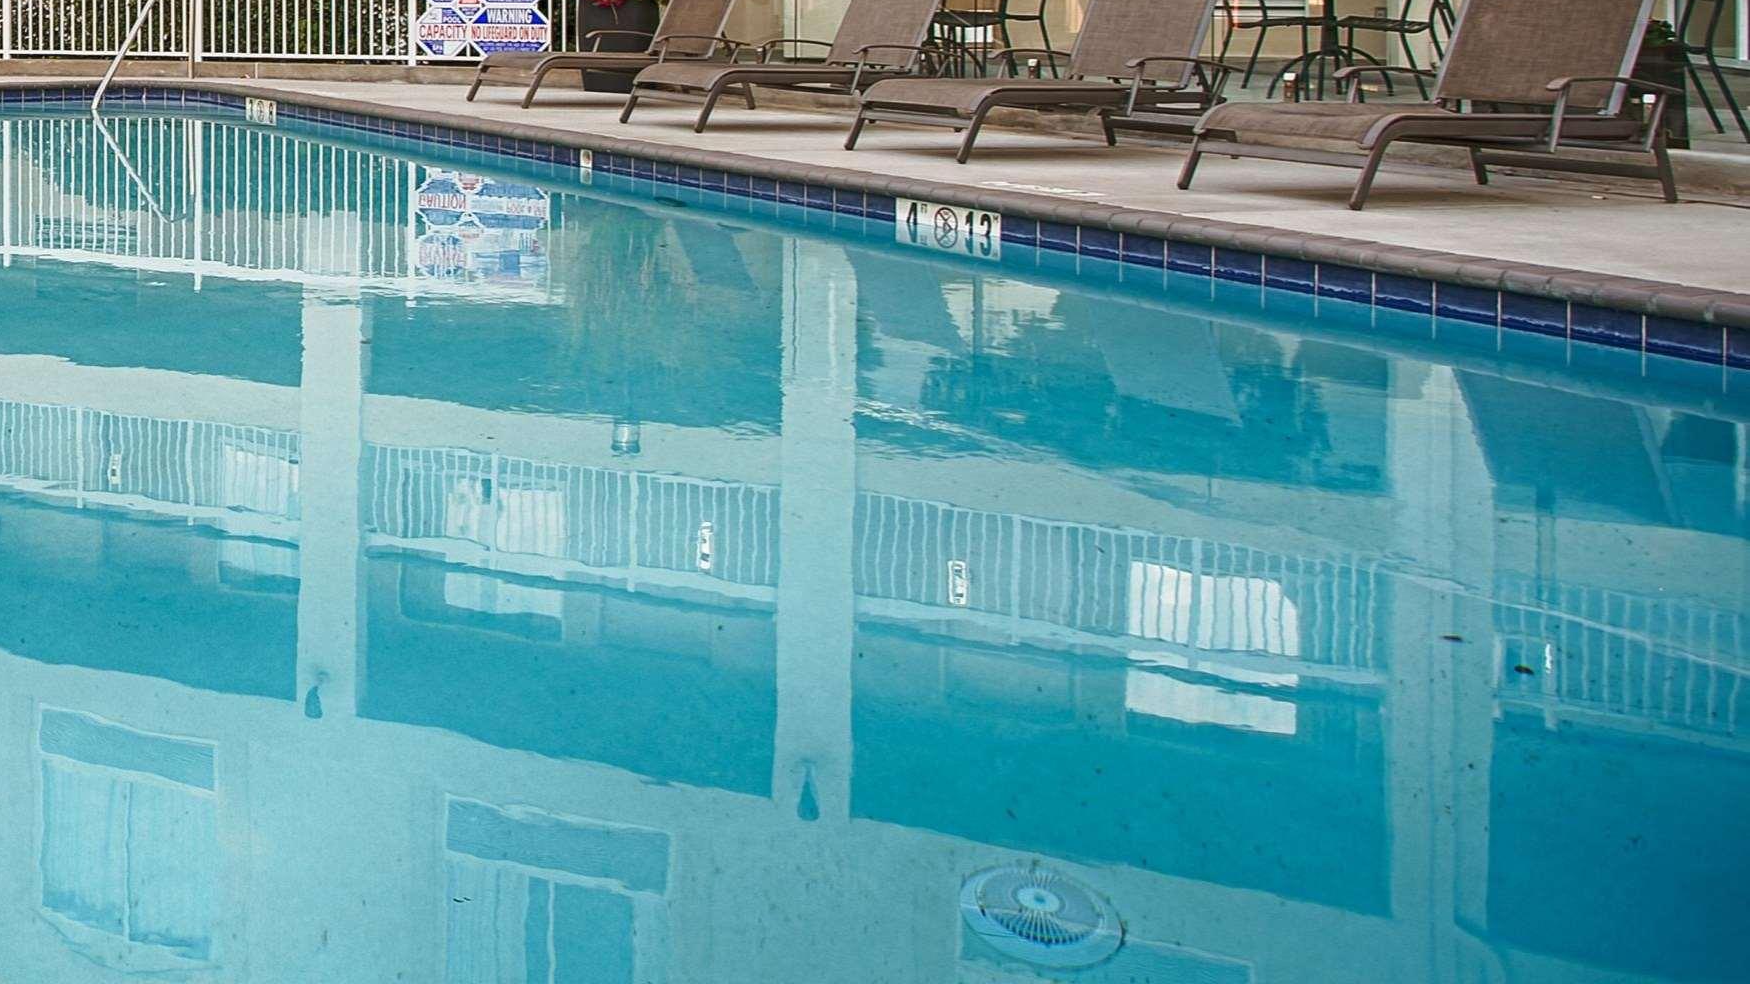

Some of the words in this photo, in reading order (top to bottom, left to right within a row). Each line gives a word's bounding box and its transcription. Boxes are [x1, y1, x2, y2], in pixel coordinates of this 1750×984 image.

[486, 8, 533, 23] WARNING
[419, 24, 467, 38] CAPACITY
[471, 26, 481, 40] NO
[483, 26, 518, 40] LIFEGUARD
[519, 26, 529, 40] ON
[530, 26, 548, 40] DUTY
